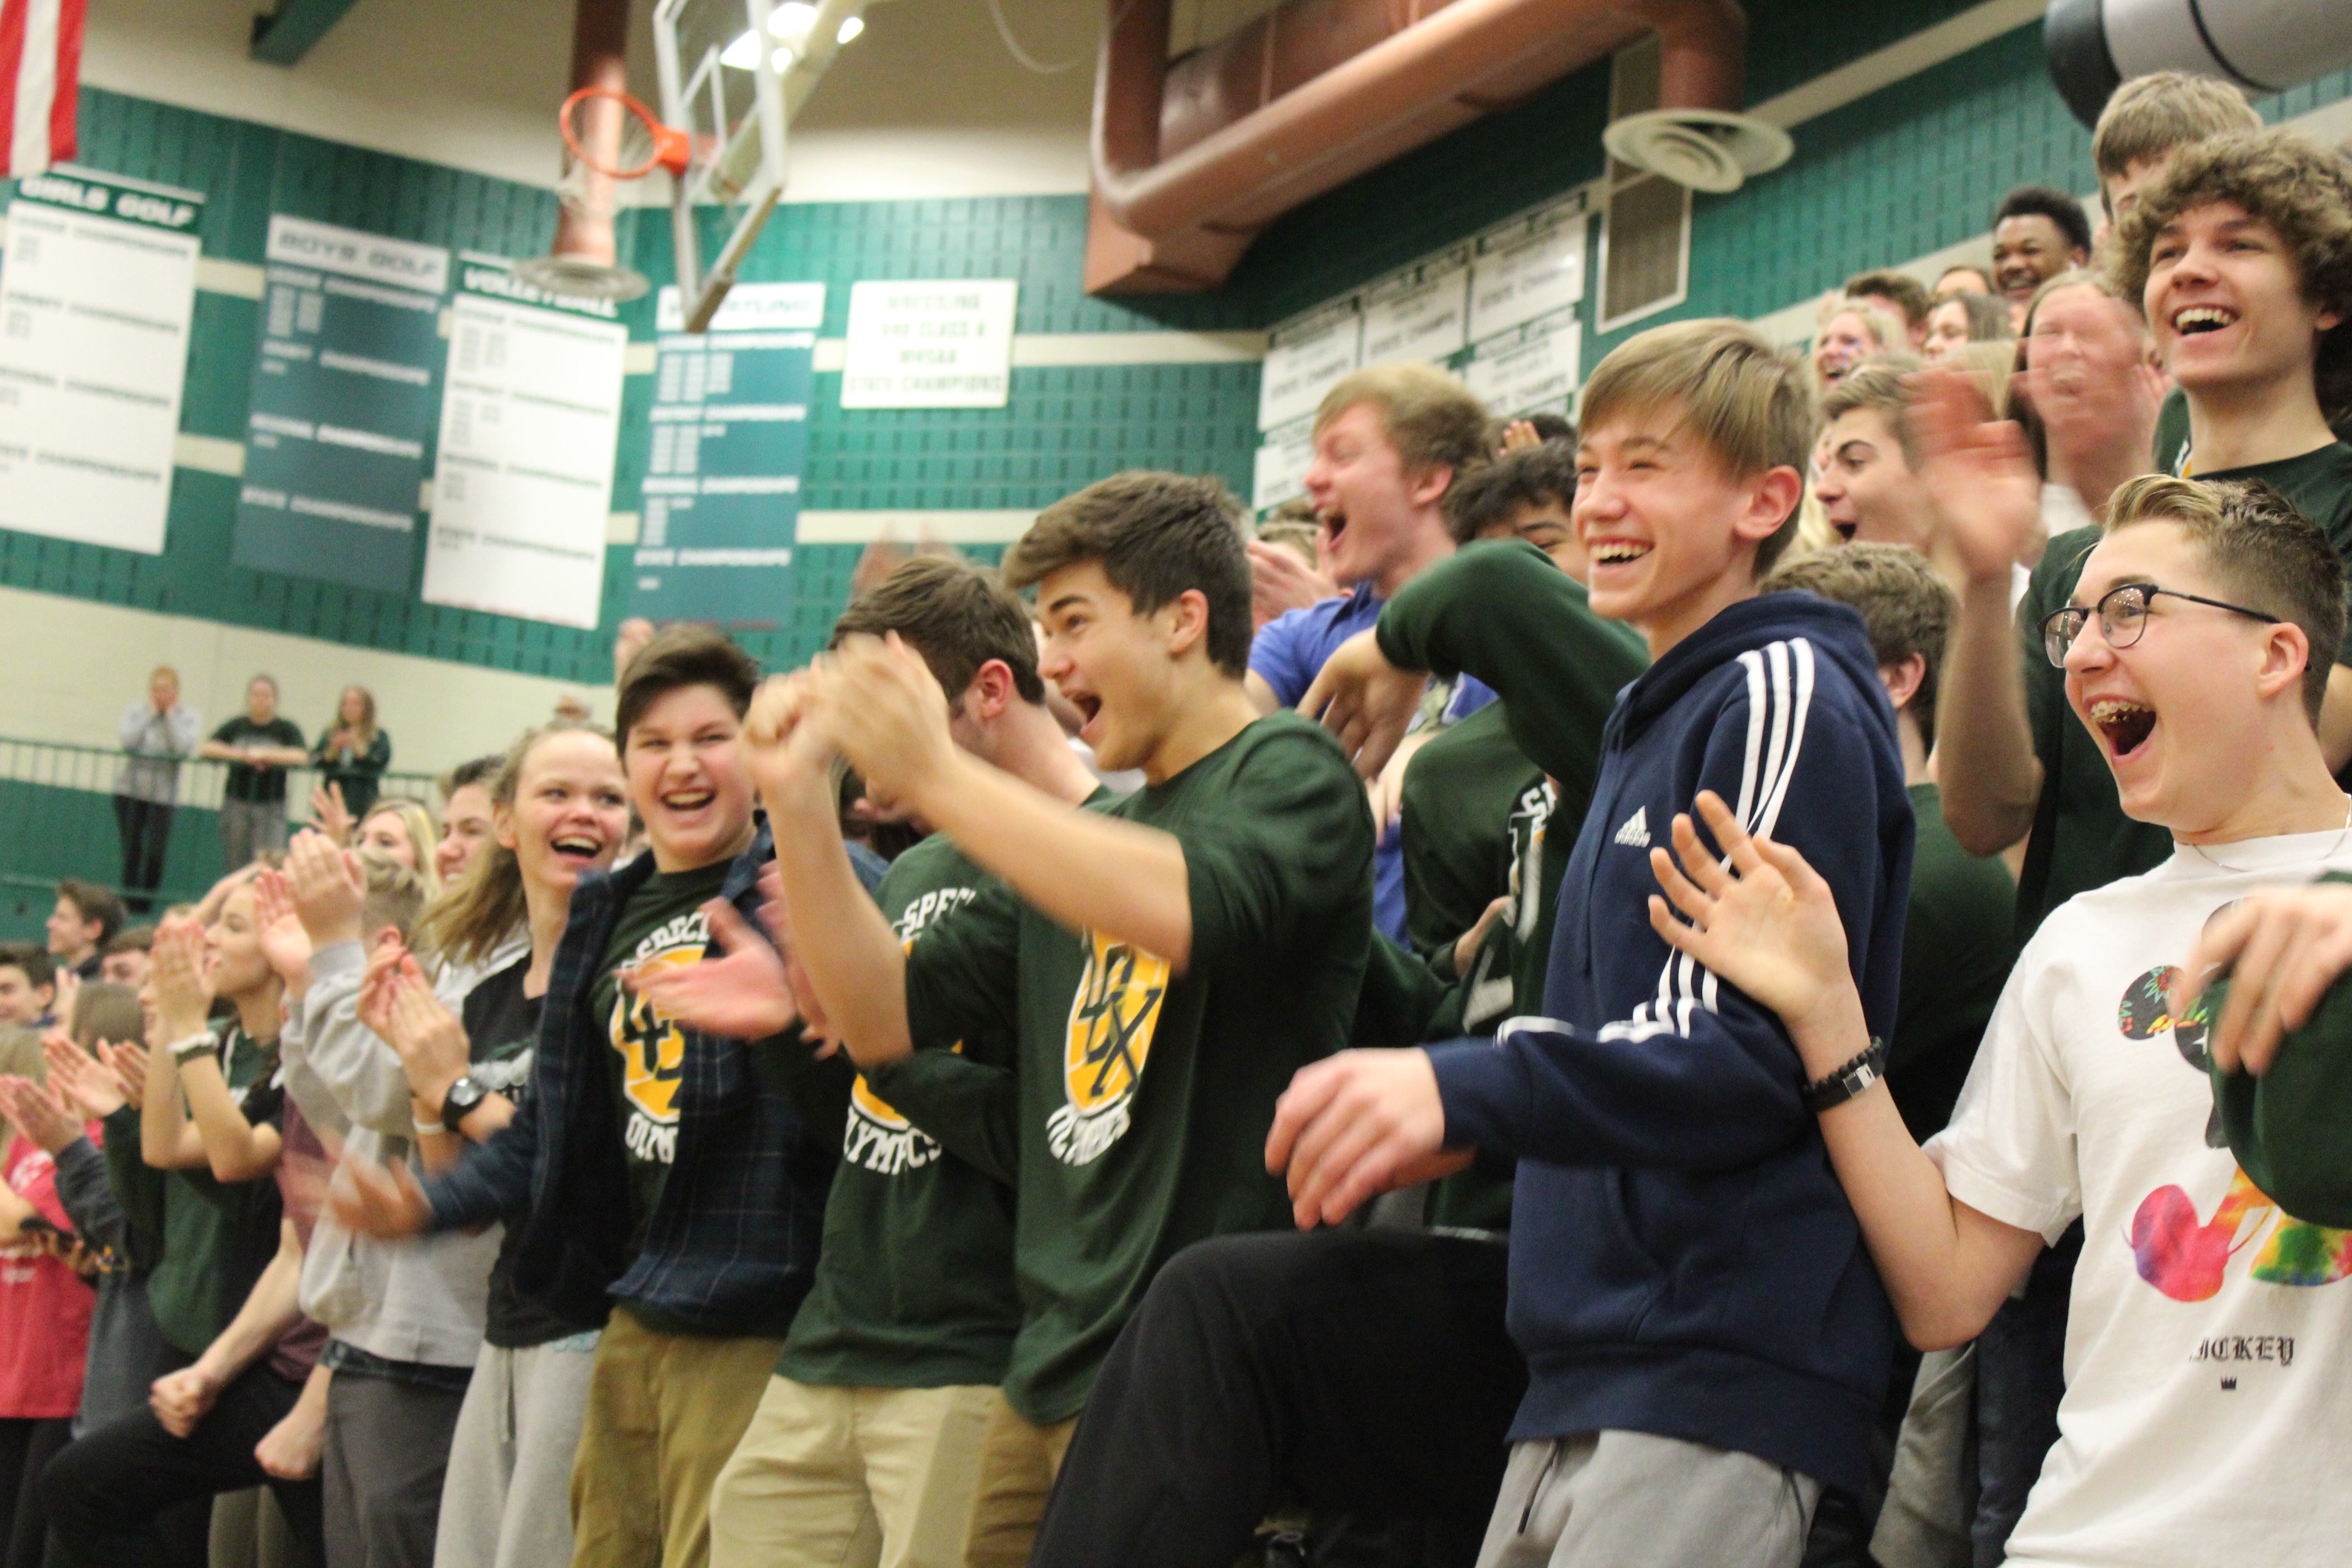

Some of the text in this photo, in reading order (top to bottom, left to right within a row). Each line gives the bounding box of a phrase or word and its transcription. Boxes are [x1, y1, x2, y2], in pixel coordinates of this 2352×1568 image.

[20, 177, 195, 227] GIRLS GOLF
[278, 231, 438, 276] BOYS GOLF
[2189, 1334, 2295, 1367] ICKEY
